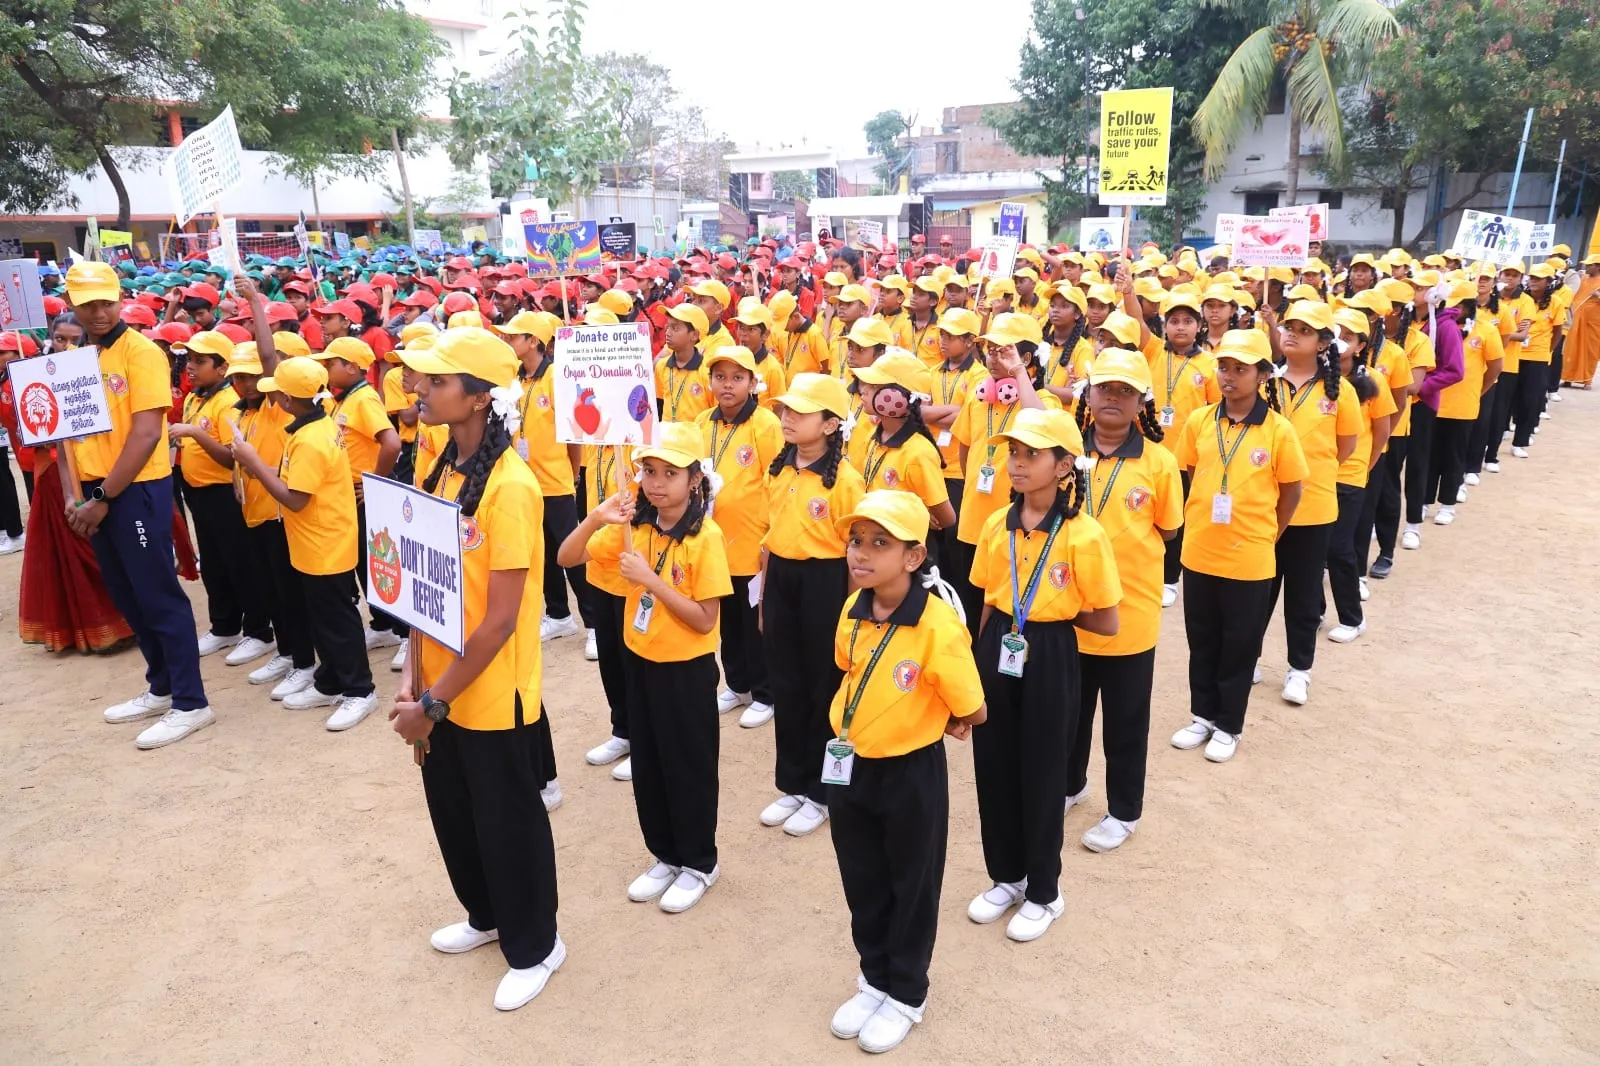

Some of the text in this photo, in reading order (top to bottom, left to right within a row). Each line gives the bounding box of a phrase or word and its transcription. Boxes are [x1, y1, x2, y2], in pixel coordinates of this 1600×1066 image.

[1108, 111, 1155, 126] Follow
[1107, 126, 1161, 137] traffic rules,
[191, 135, 206, 145] ONE
[1107, 137, 1158, 150] save your
[190, 140, 212, 154] TISSUE
[1106, 149, 1129, 158] future
[191, 146, 216, 163] DONOR
[197, 158, 213, 168] CAN
[198, 165, 216, 177] HEAL
[199, 171, 220, 185] UP TO
[205, 188, 223, 200] LIVES
[575, 331, 637, 344] Donate organ
[563, 364, 586, 382] Organ
[588, 363, 633, 379] Donation
[135, 520, 148, 548] SDAT
[401, 535, 456, 593] DON'T ABUSE
[413, 578, 445, 626] REFUSE
